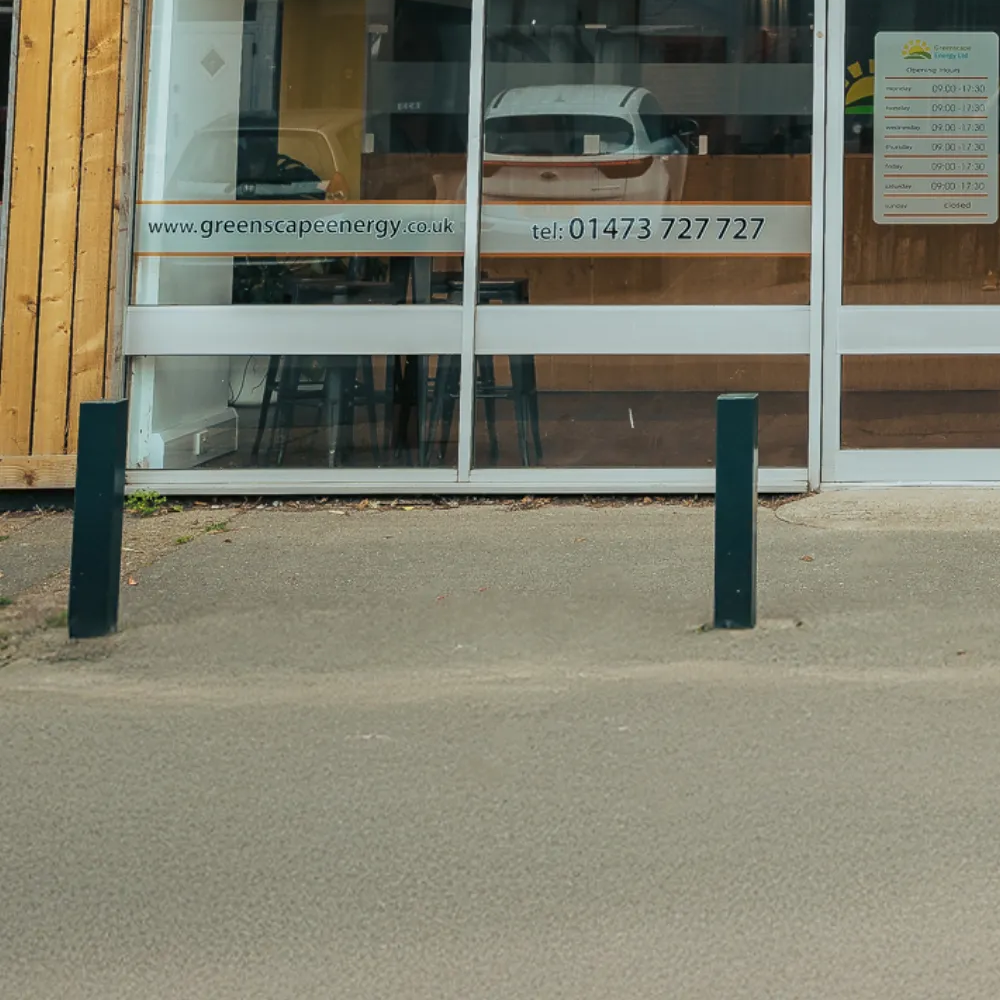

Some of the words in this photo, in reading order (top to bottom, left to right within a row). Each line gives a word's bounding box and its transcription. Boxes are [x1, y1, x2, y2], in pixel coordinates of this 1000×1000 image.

[944, 201, 972, 209] closed
[148, 216, 454, 239] www.greenscapeenergy.co.uk
[531, 222, 563, 240] tel:
[568, 217, 652, 240] 01473
[660, 217, 710, 240] 727
[716, 217, 766, 240] 727
